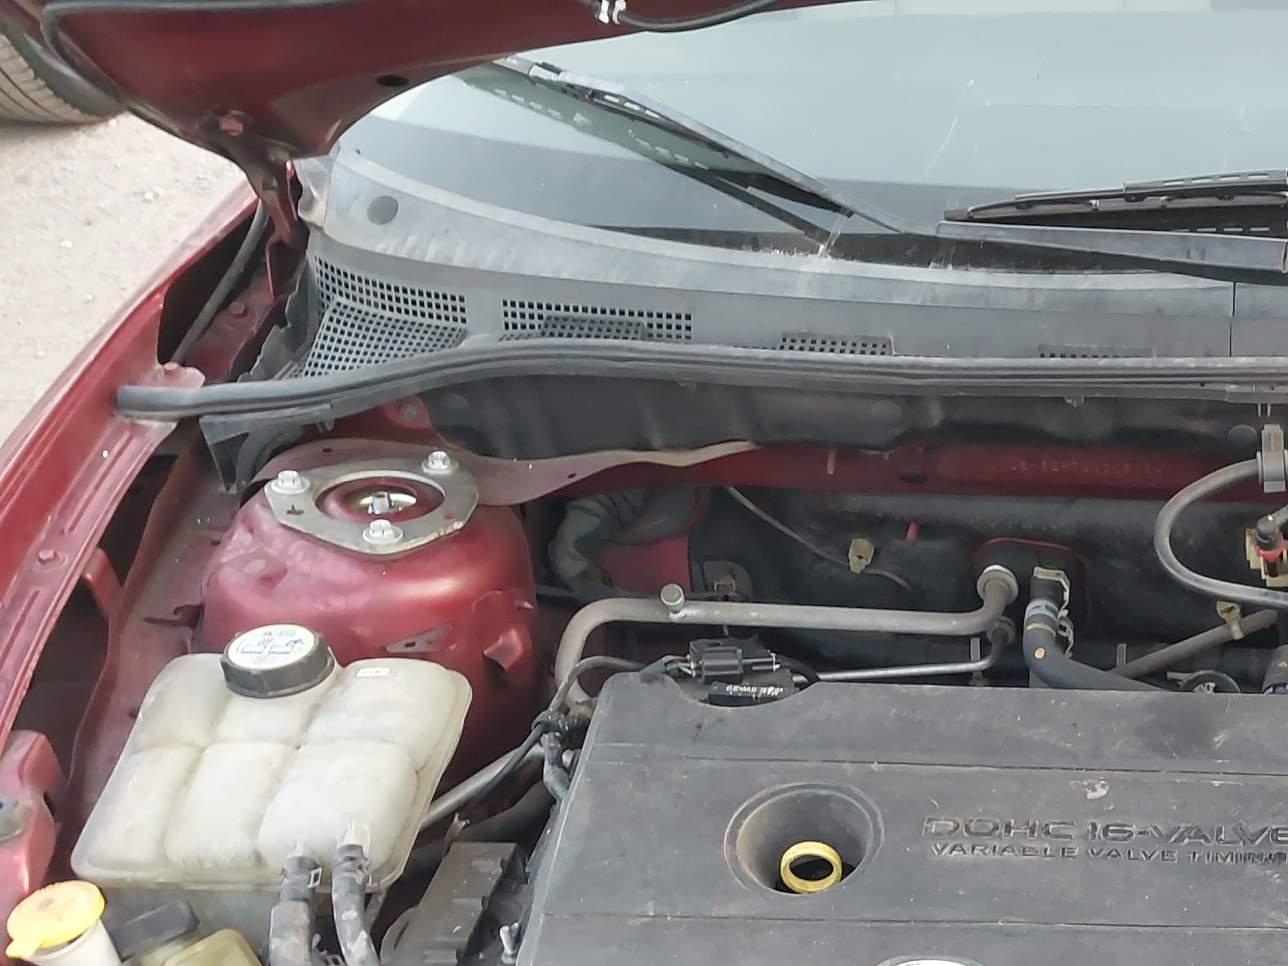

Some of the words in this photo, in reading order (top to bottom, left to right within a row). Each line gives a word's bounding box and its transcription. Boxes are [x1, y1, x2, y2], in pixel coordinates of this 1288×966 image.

[923, 816, 1081, 842] DOHC
[930, 843, 1080, 860] VARIABLE
[1088, 847, 1178, 864] VALVE
